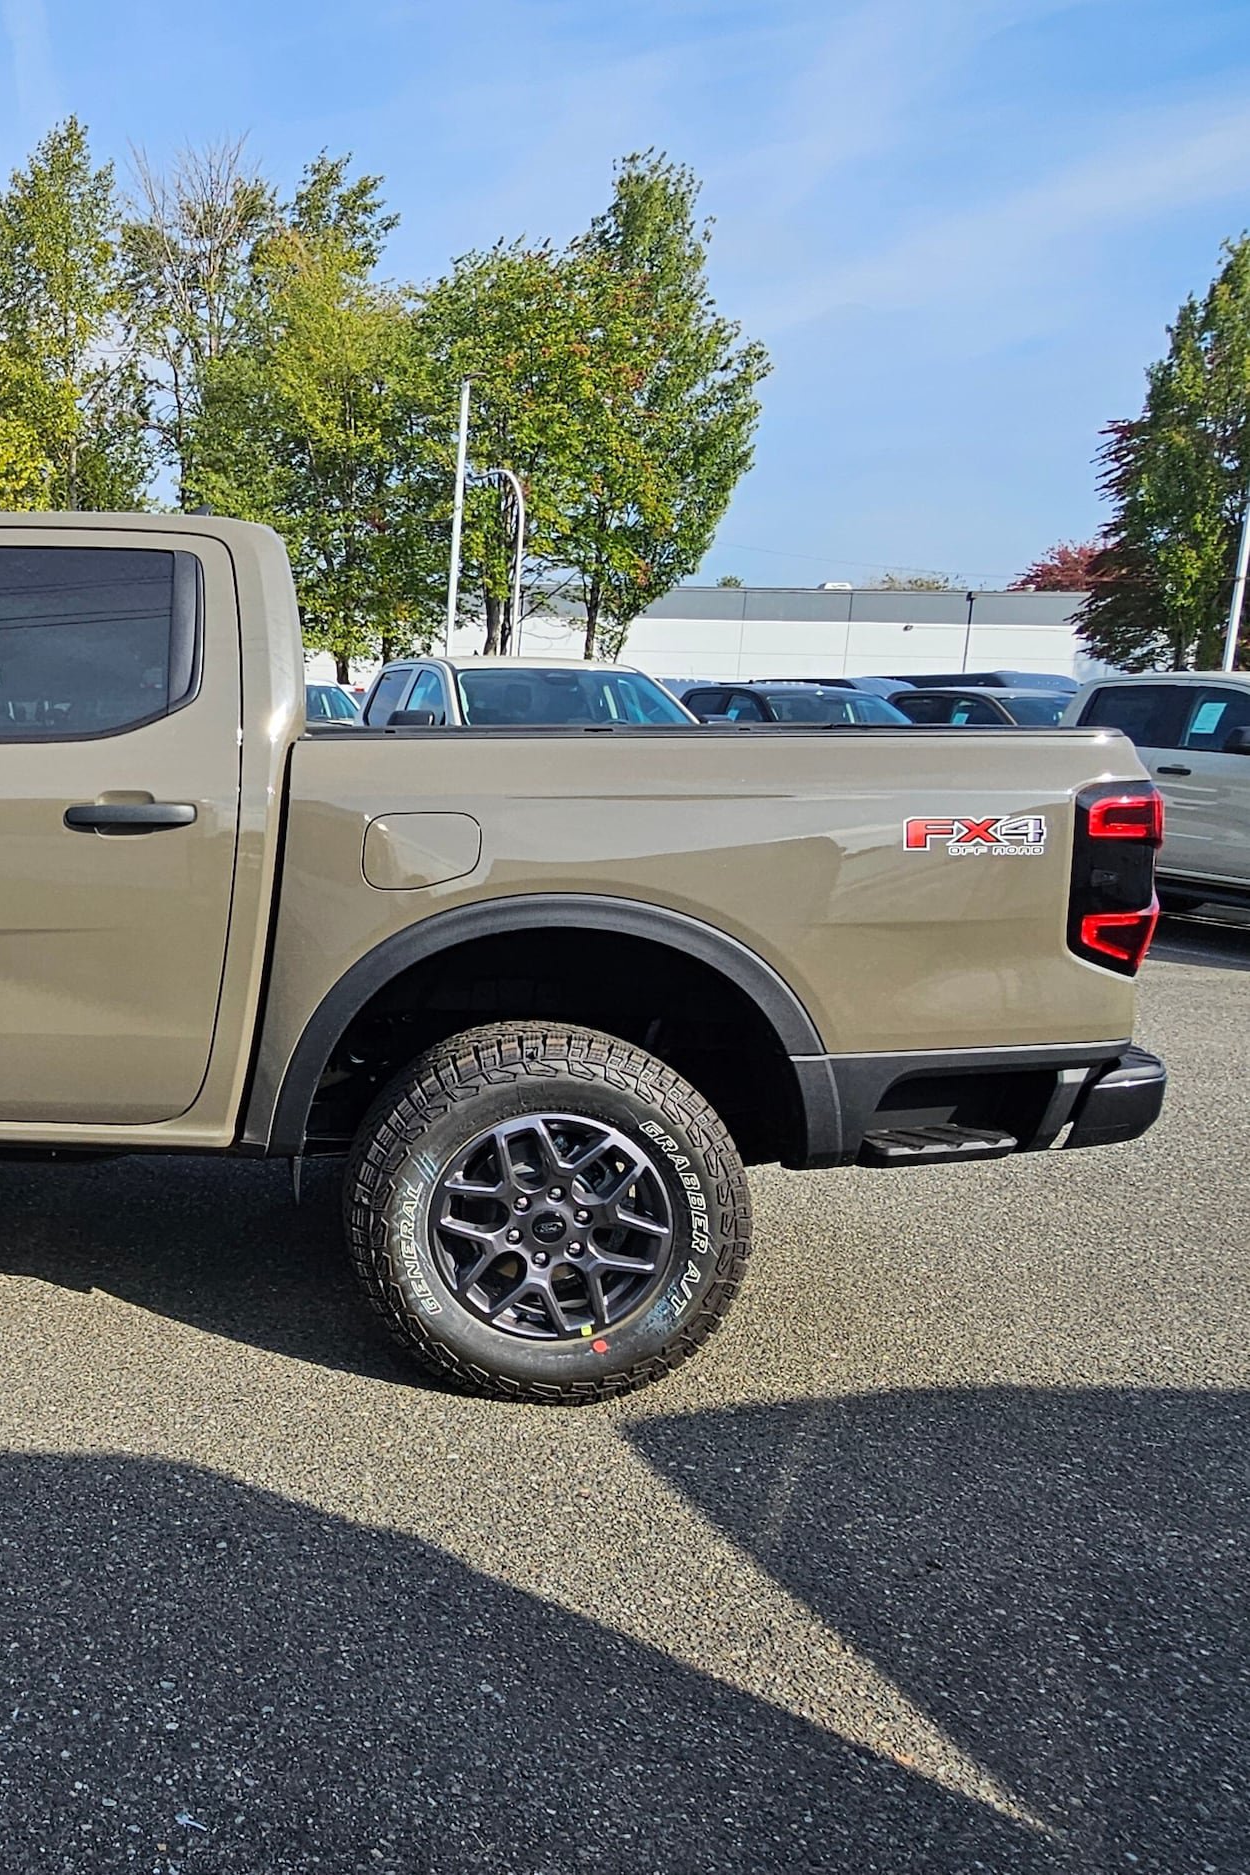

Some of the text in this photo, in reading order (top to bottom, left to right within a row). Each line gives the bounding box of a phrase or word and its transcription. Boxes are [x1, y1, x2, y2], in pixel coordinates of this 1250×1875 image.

[903, 816, 1046, 851] FX4
[948, 846, 1044, 855] OFF ROAD
[400, 1182, 442, 1315] GENERAL
[639, 1120, 708, 1316] GRABBER A/T
